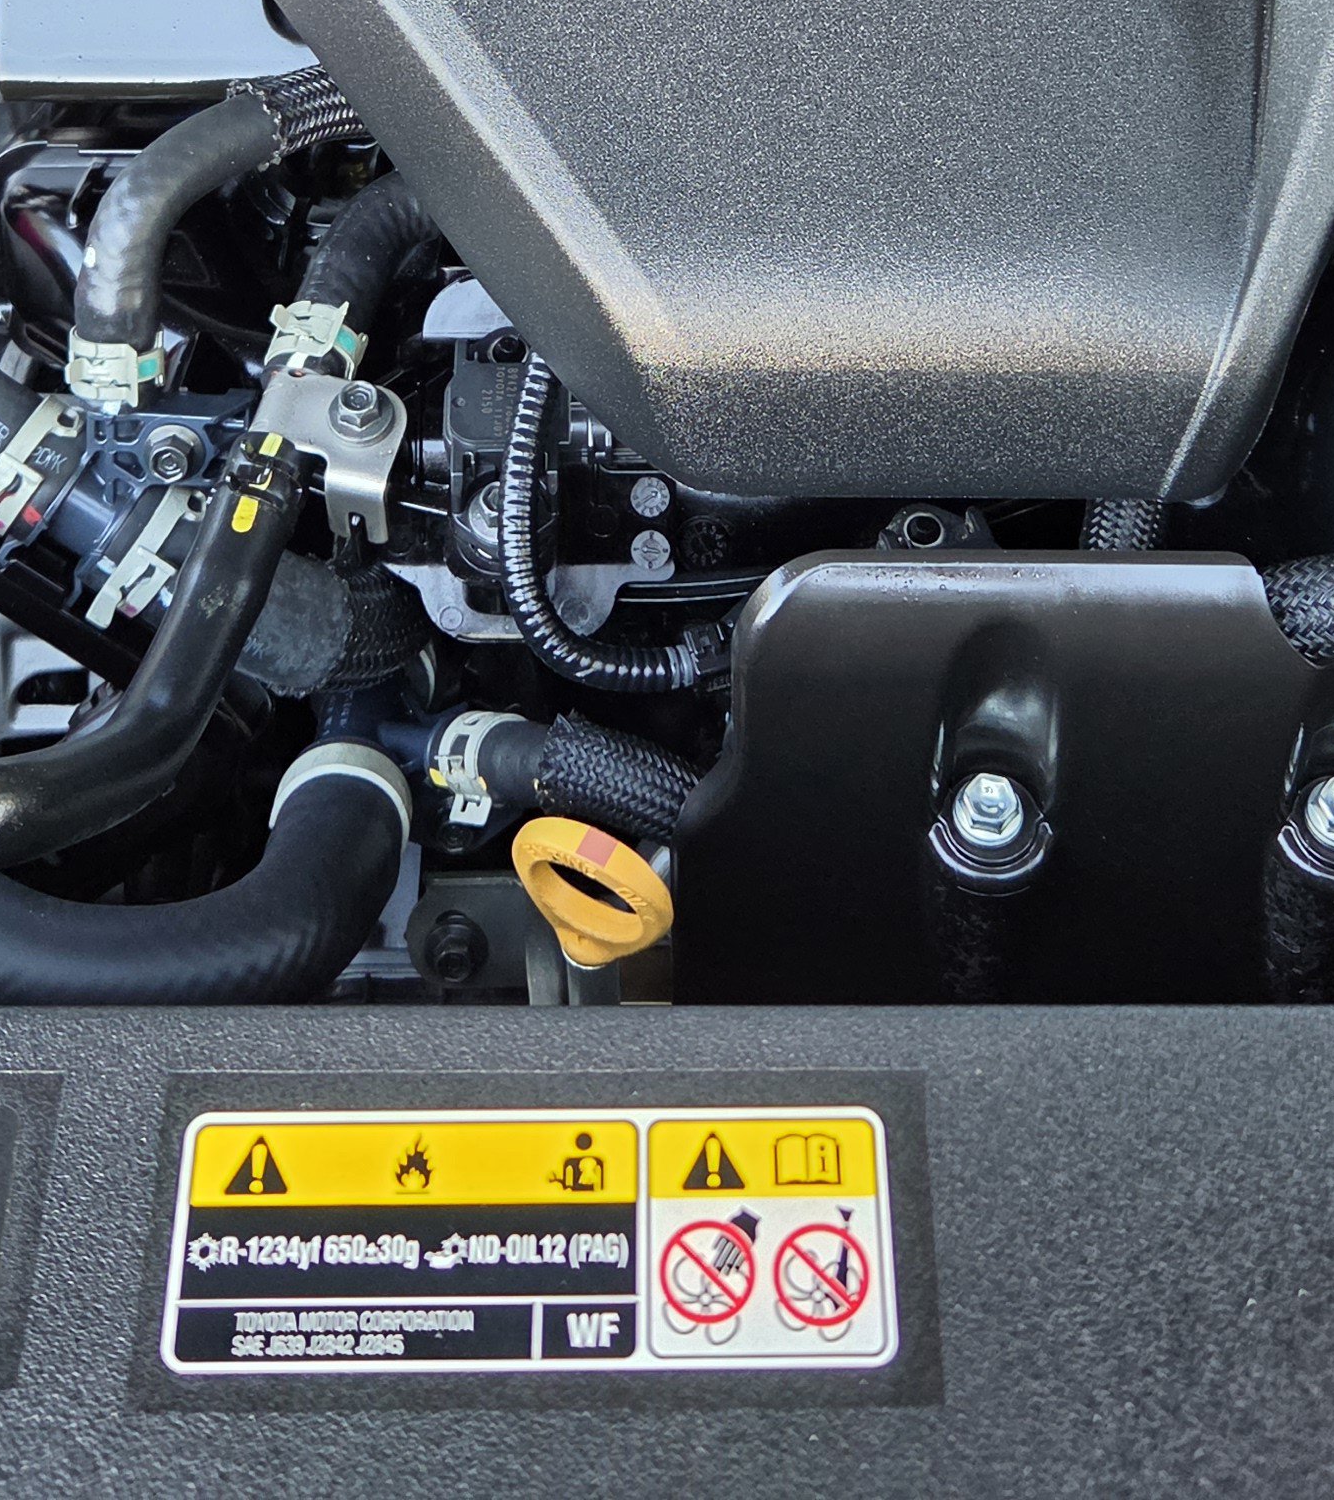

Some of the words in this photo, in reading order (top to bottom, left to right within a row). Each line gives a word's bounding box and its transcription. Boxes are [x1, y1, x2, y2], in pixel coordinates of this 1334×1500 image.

[218, 1235, 322, 1271] R-1234yf
[323, 1234, 421, 1270] 650±30g
[569, 1232, 630, 1270] (PAG)
[234, 1311, 298, 1334] TOYOTA
[298, 1310, 359, 1334] MOTOR
[359, 1310, 475, 1333] CORPORATION
[566, 1312, 621, 1348] WF
